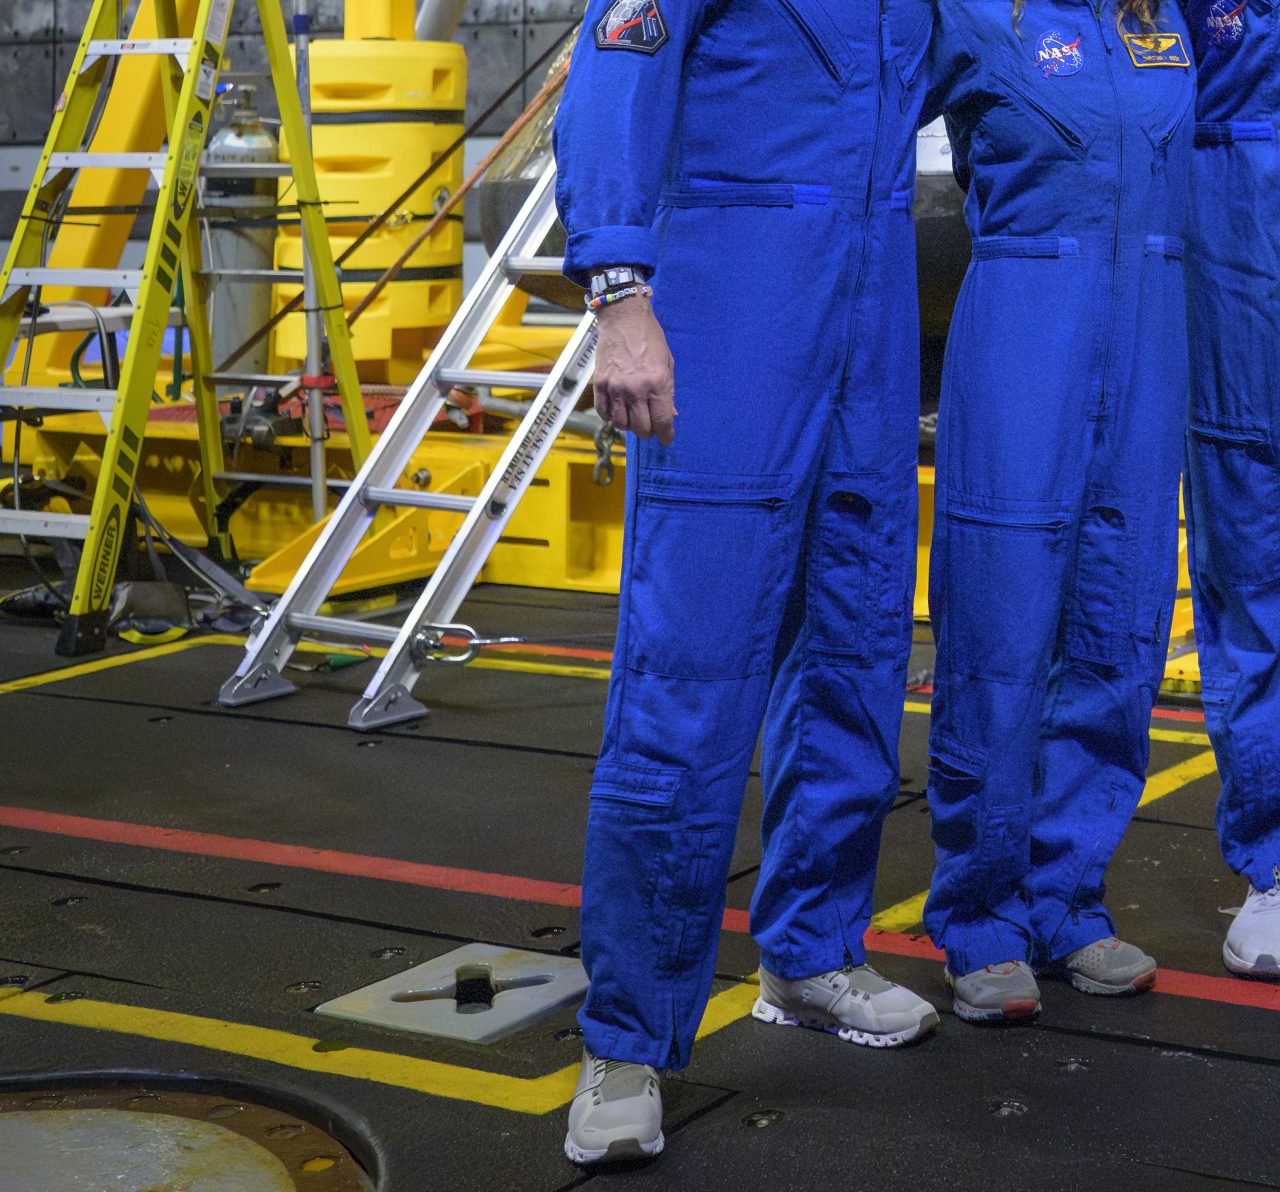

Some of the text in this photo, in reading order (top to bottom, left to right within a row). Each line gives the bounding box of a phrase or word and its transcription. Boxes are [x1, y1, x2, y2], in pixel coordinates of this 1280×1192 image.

[1038, 46, 1081, 60] NASA
[508, 405, 562, 490] FOR USE AT SEA
[93, 525, 116, 601] WERNER
